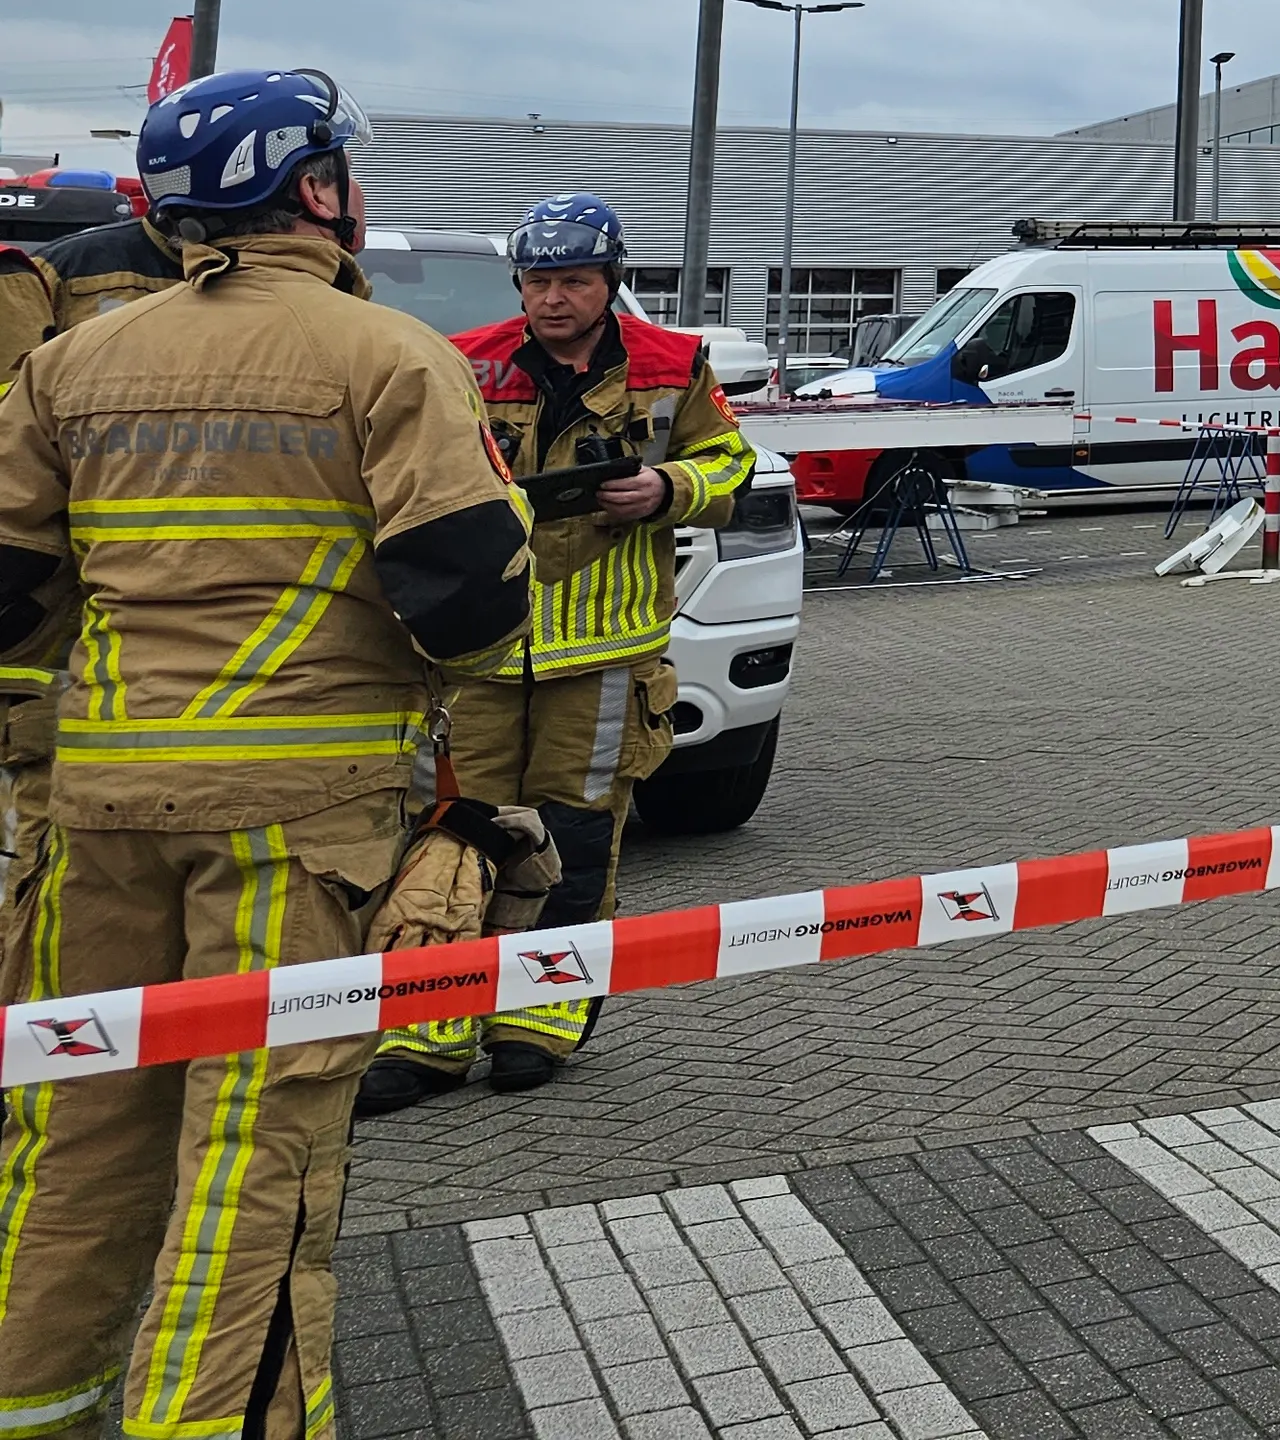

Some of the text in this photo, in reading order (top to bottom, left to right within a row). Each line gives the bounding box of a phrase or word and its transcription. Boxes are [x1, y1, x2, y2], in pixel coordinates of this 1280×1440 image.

[532, 245, 567, 256] KASK
[65, 422, 339, 460] BRANDWEER
[150, 464, 222, 482] Twente
[1106, 857, 1263, 891] WAGENBORG NEDLIFT
[727, 907, 912, 949] WAGENBORG NEDLIFT
[267, 970, 489, 1017] WAGENBORG NEDLIFT
